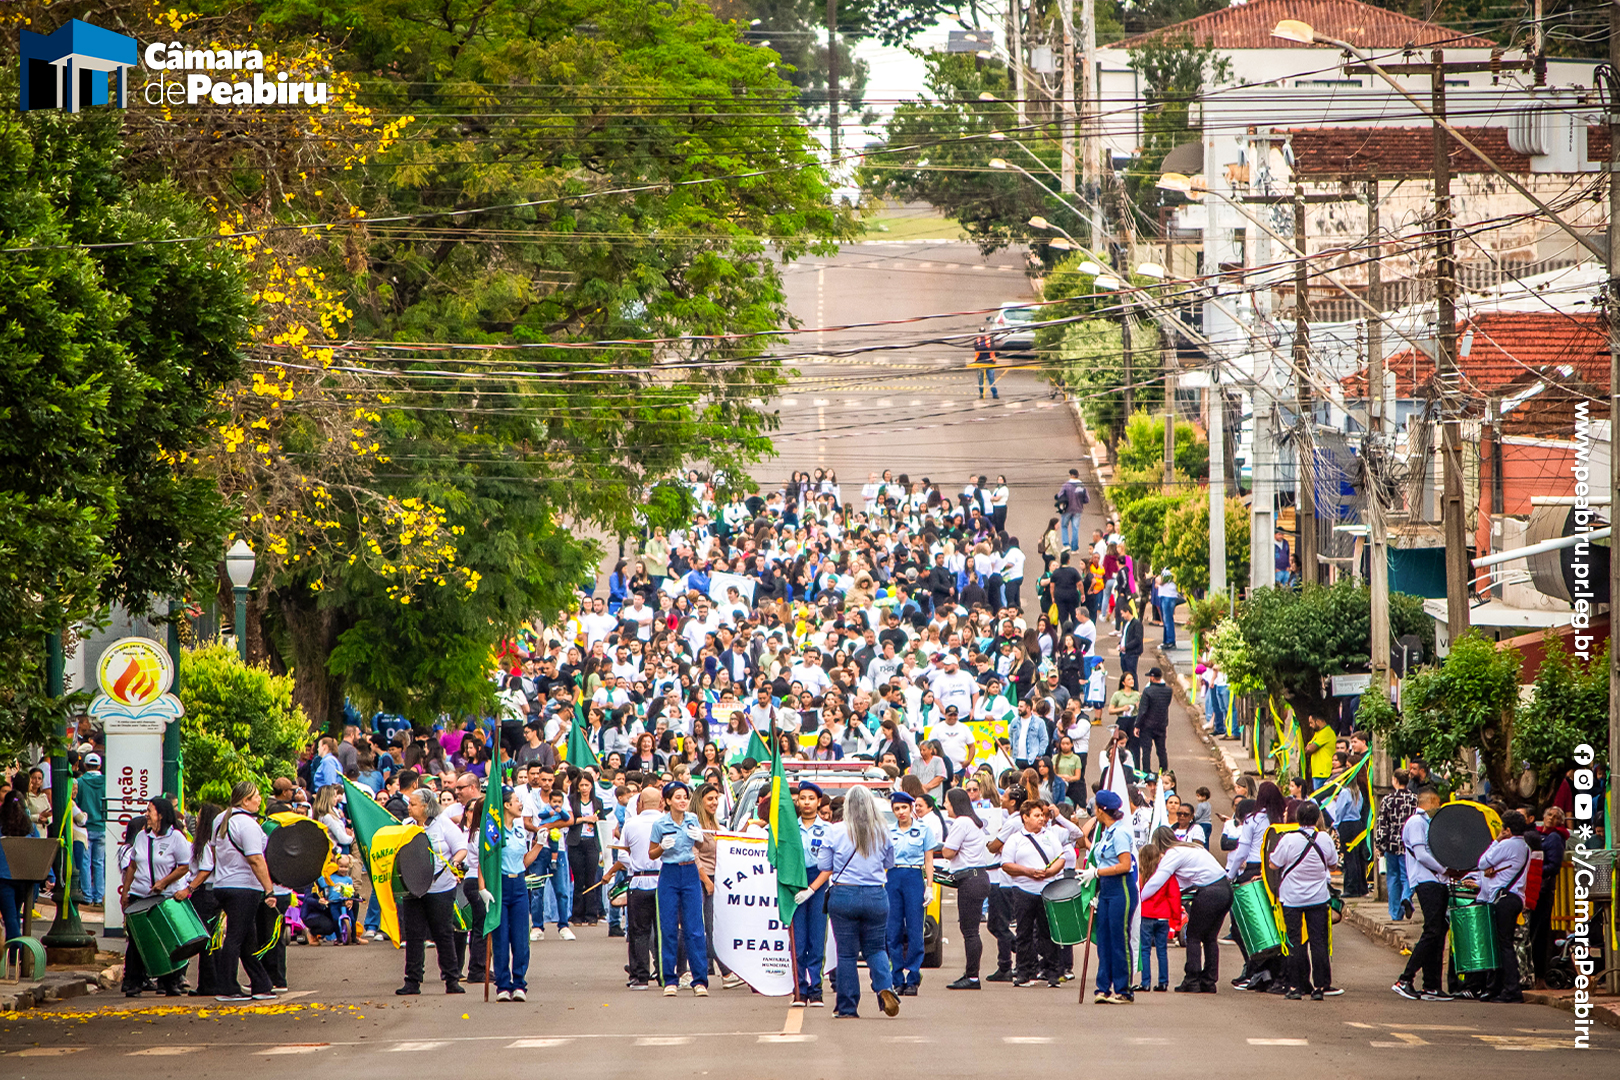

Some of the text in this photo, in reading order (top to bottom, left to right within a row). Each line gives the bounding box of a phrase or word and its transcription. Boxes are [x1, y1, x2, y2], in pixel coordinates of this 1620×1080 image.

[118, 766, 137, 826] Oração
[137, 769, 148, 805] Povos
[730, 847, 768, 857] ENCONT
